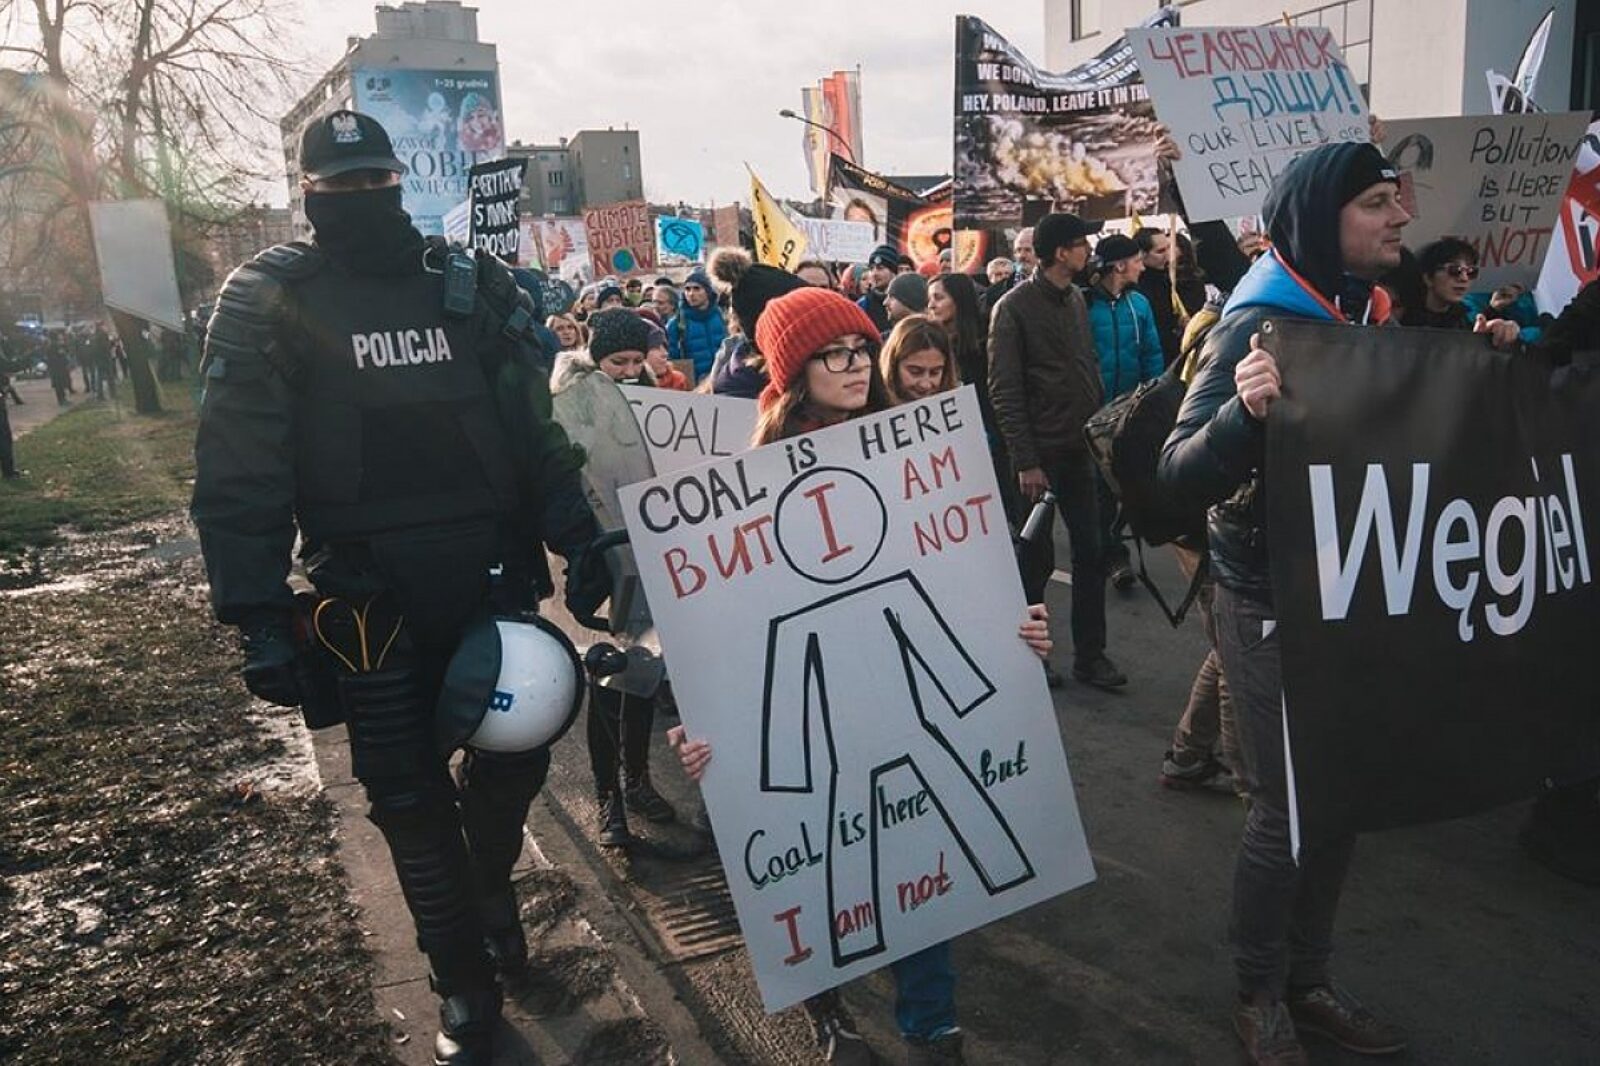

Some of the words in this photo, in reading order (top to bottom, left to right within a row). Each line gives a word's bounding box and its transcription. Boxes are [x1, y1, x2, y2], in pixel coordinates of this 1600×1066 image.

[977, 63, 1001, 81] WE
[963, 94, 990, 112] HEY,
[992, 94, 1049, 114] POLAND,
[1053, 91, 1096, 112] LEAVE
[1098, 89, 1113, 107] IT
[1113, 86, 1129, 105] IN
[1211, 63, 1361, 124] ДЫШИ!
[1189, 125, 1238, 155] OUR
[1505, 171, 1562, 197] HERE
[1481, 203, 1540, 223] BUT
[590, 226, 652, 250] JUSTICE
[1480, 226, 1553, 268] NOT
[352, 327, 452, 369] POLICJA
[639, 459, 768, 534] COAL
[859, 397, 963, 460] HERE
[903, 446, 962, 500] AM
[663, 514, 775, 599] BUT
[803, 482, 854, 564] I
[914, 494, 993, 557] NOT
[1308, 453, 1591, 642] Węgiel
[838, 811, 867, 847] is
[877, 785, 930, 829] here
[979, 740, 1029, 787] but
[773, 906, 812, 966] I
[834, 901, 873, 939] am
[897, 851, 953, 913] not
